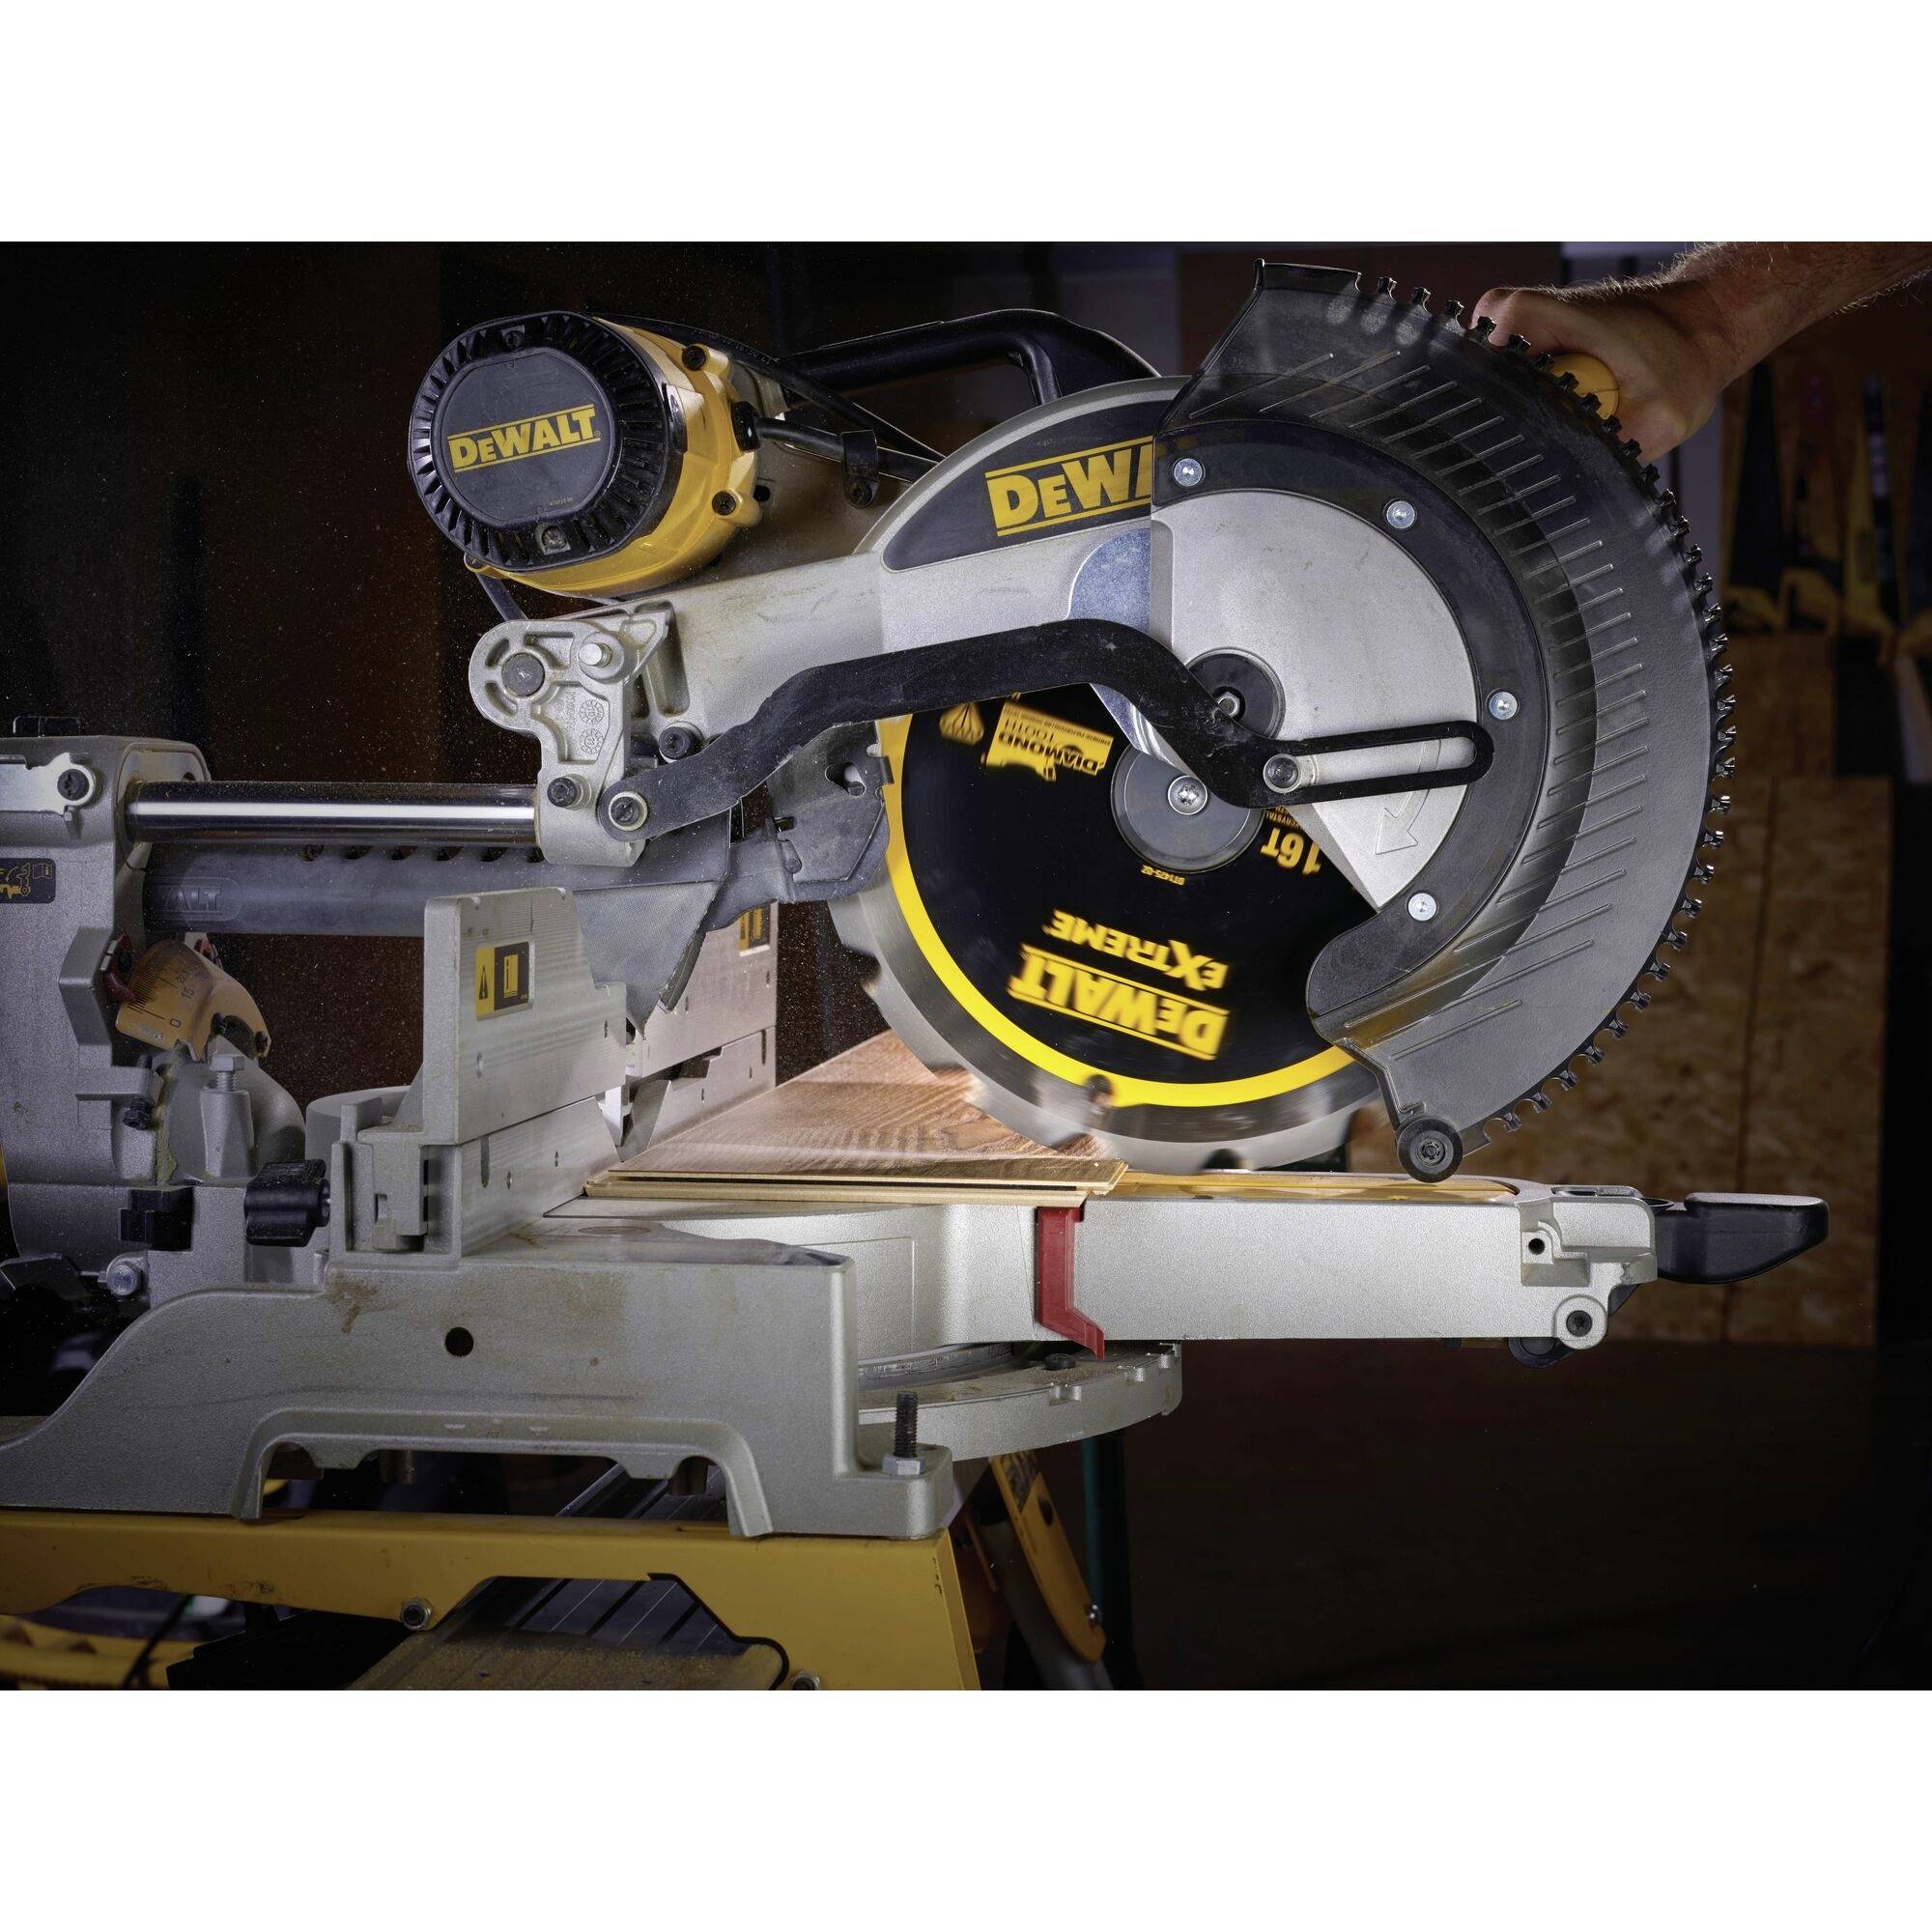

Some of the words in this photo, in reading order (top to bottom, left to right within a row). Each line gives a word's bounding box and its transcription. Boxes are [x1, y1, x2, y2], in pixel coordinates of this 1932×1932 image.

[448, 408, 596, 469] DEWALT
[999, 733, 1098, 775] DIAMOND
[1260, 828, 1321, 875] 16T
[1051, 909, 1230, 991] EXTREME
[169, 1018, 182, 1028] 0
[1008, 952, 1228, 1055] DEWALT
